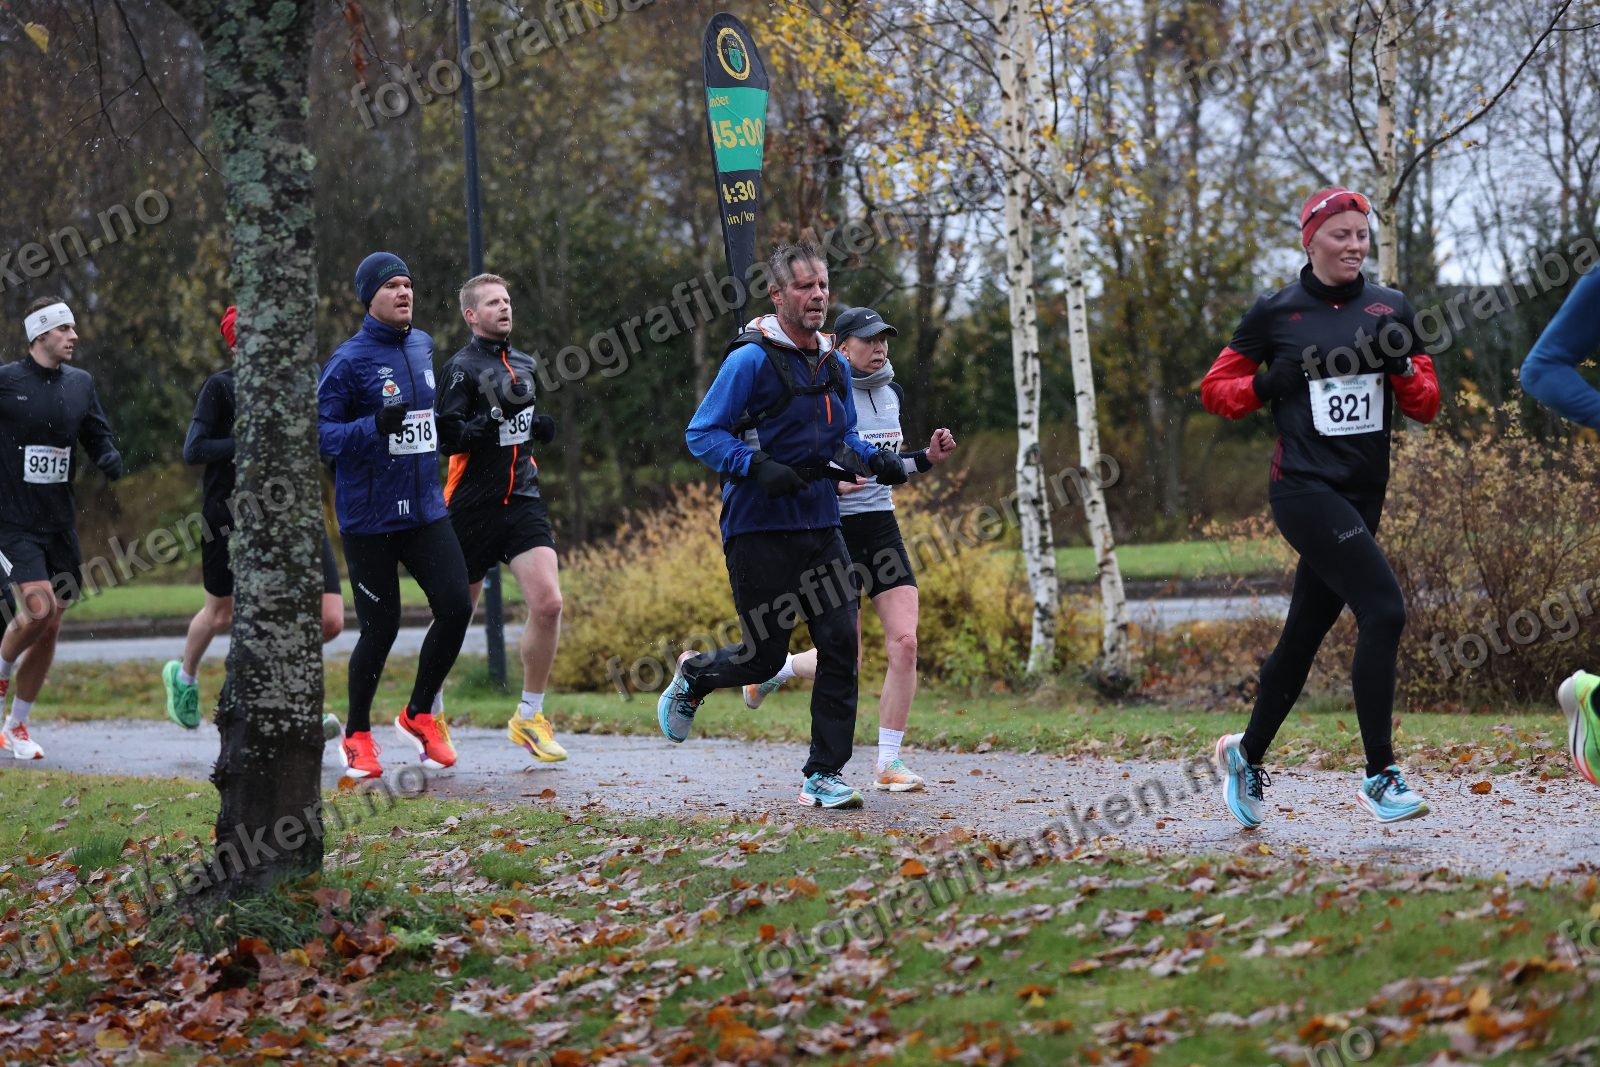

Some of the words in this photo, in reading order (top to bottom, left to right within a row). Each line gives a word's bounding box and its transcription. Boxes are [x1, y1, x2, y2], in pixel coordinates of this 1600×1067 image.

[1328, 392, 1370, 423] 821
[29, 455, 68, 474] 9315
[397, 498, 410, 516] TN
